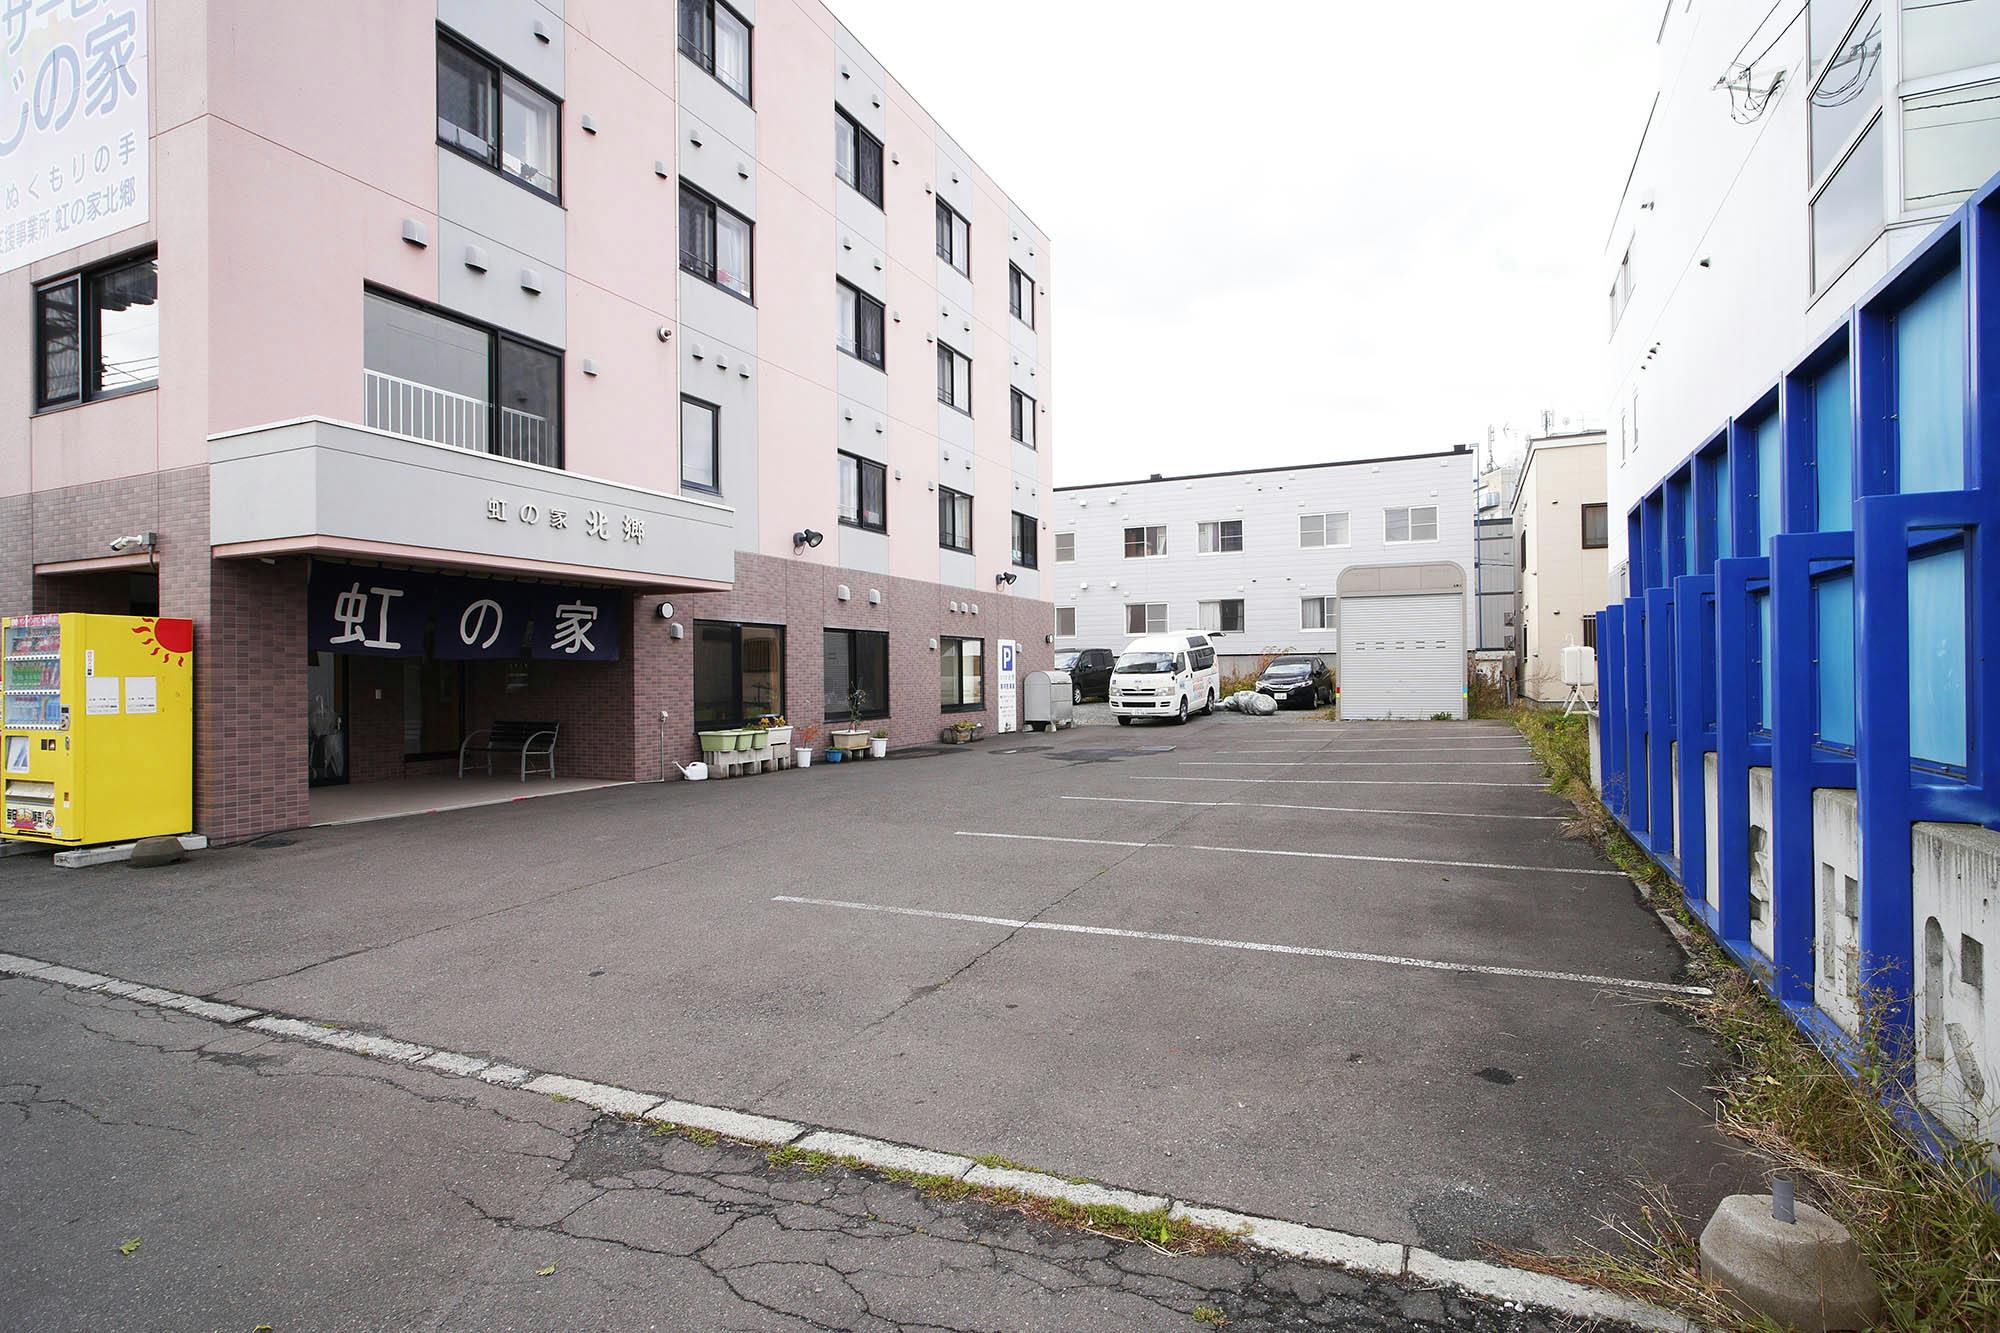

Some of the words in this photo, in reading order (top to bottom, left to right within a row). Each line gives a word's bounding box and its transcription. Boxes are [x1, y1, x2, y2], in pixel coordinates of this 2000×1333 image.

[5, 131, 136, 210] ぬくもりの手
[0, 208, 50, 254] 援事業所
[55, 175, 136, 233] 虹の家北郷
[329, 581, 599, 654] 虹の家
